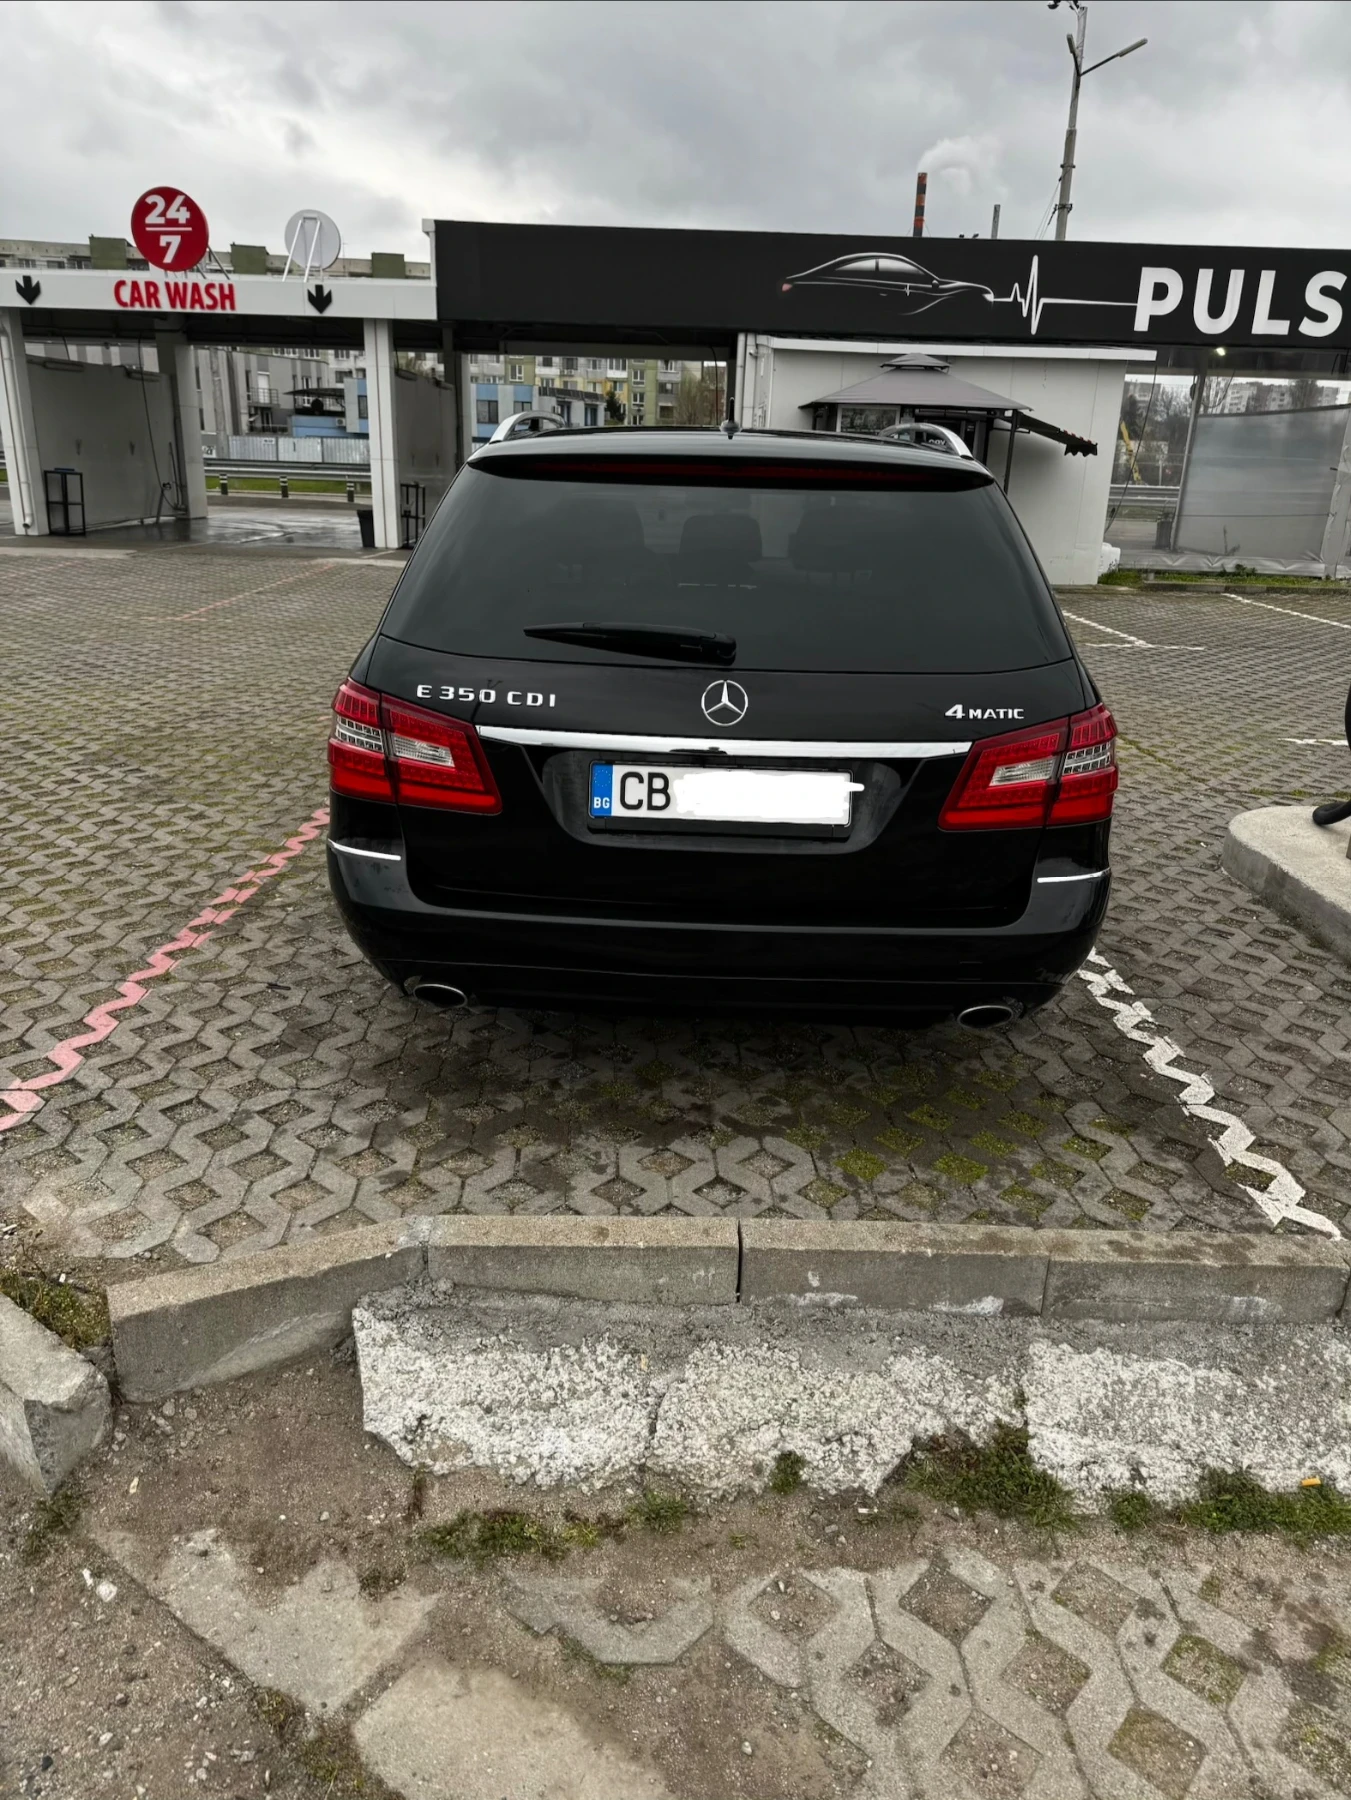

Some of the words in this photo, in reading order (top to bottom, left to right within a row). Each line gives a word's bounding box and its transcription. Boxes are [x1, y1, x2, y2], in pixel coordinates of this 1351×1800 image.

[145, 194, 190, 224] 24
[159, 235, 181, 263] 7
[114, 279, 162, 309] CAR
[164, 281, 236, 311] WASH
[1134, 267, 1348, 337] PULS
[416, 684, 433, 698] E
[439, 686, 496, 704] 350
[507, 691, 556, 707] CDI
[593, 797, 610, 809] BG
[620, 771, 671, 811] CB
